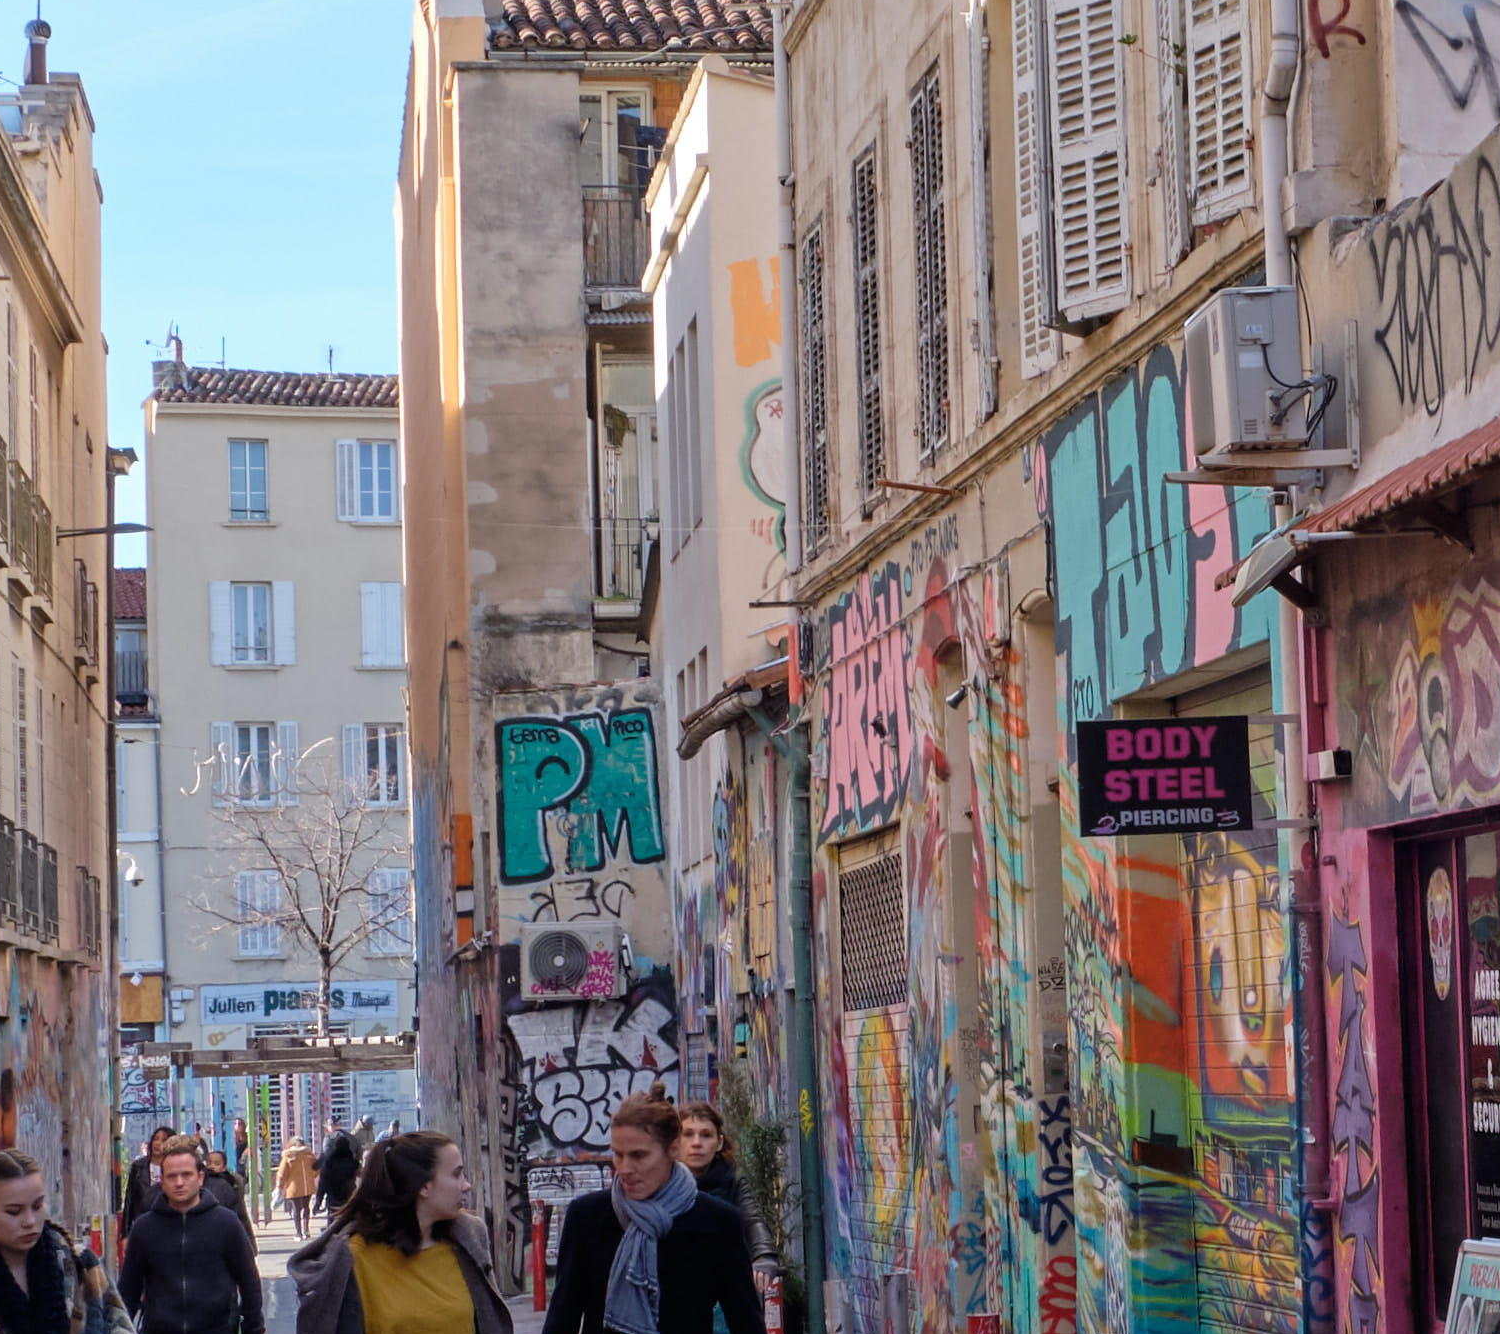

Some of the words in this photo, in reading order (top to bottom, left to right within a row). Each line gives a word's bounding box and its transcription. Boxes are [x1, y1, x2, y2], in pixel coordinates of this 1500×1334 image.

[1105, 725, 1218, 762] BODY
[1103, 765, 1226, 803] STEEL
[1119, 807, 1214, 827] PIERCING
[1474, 969, 1500, 1001] AGREE
[208, 996, 256, 1015] Julien
[263, 989, 345, 1017] pians
